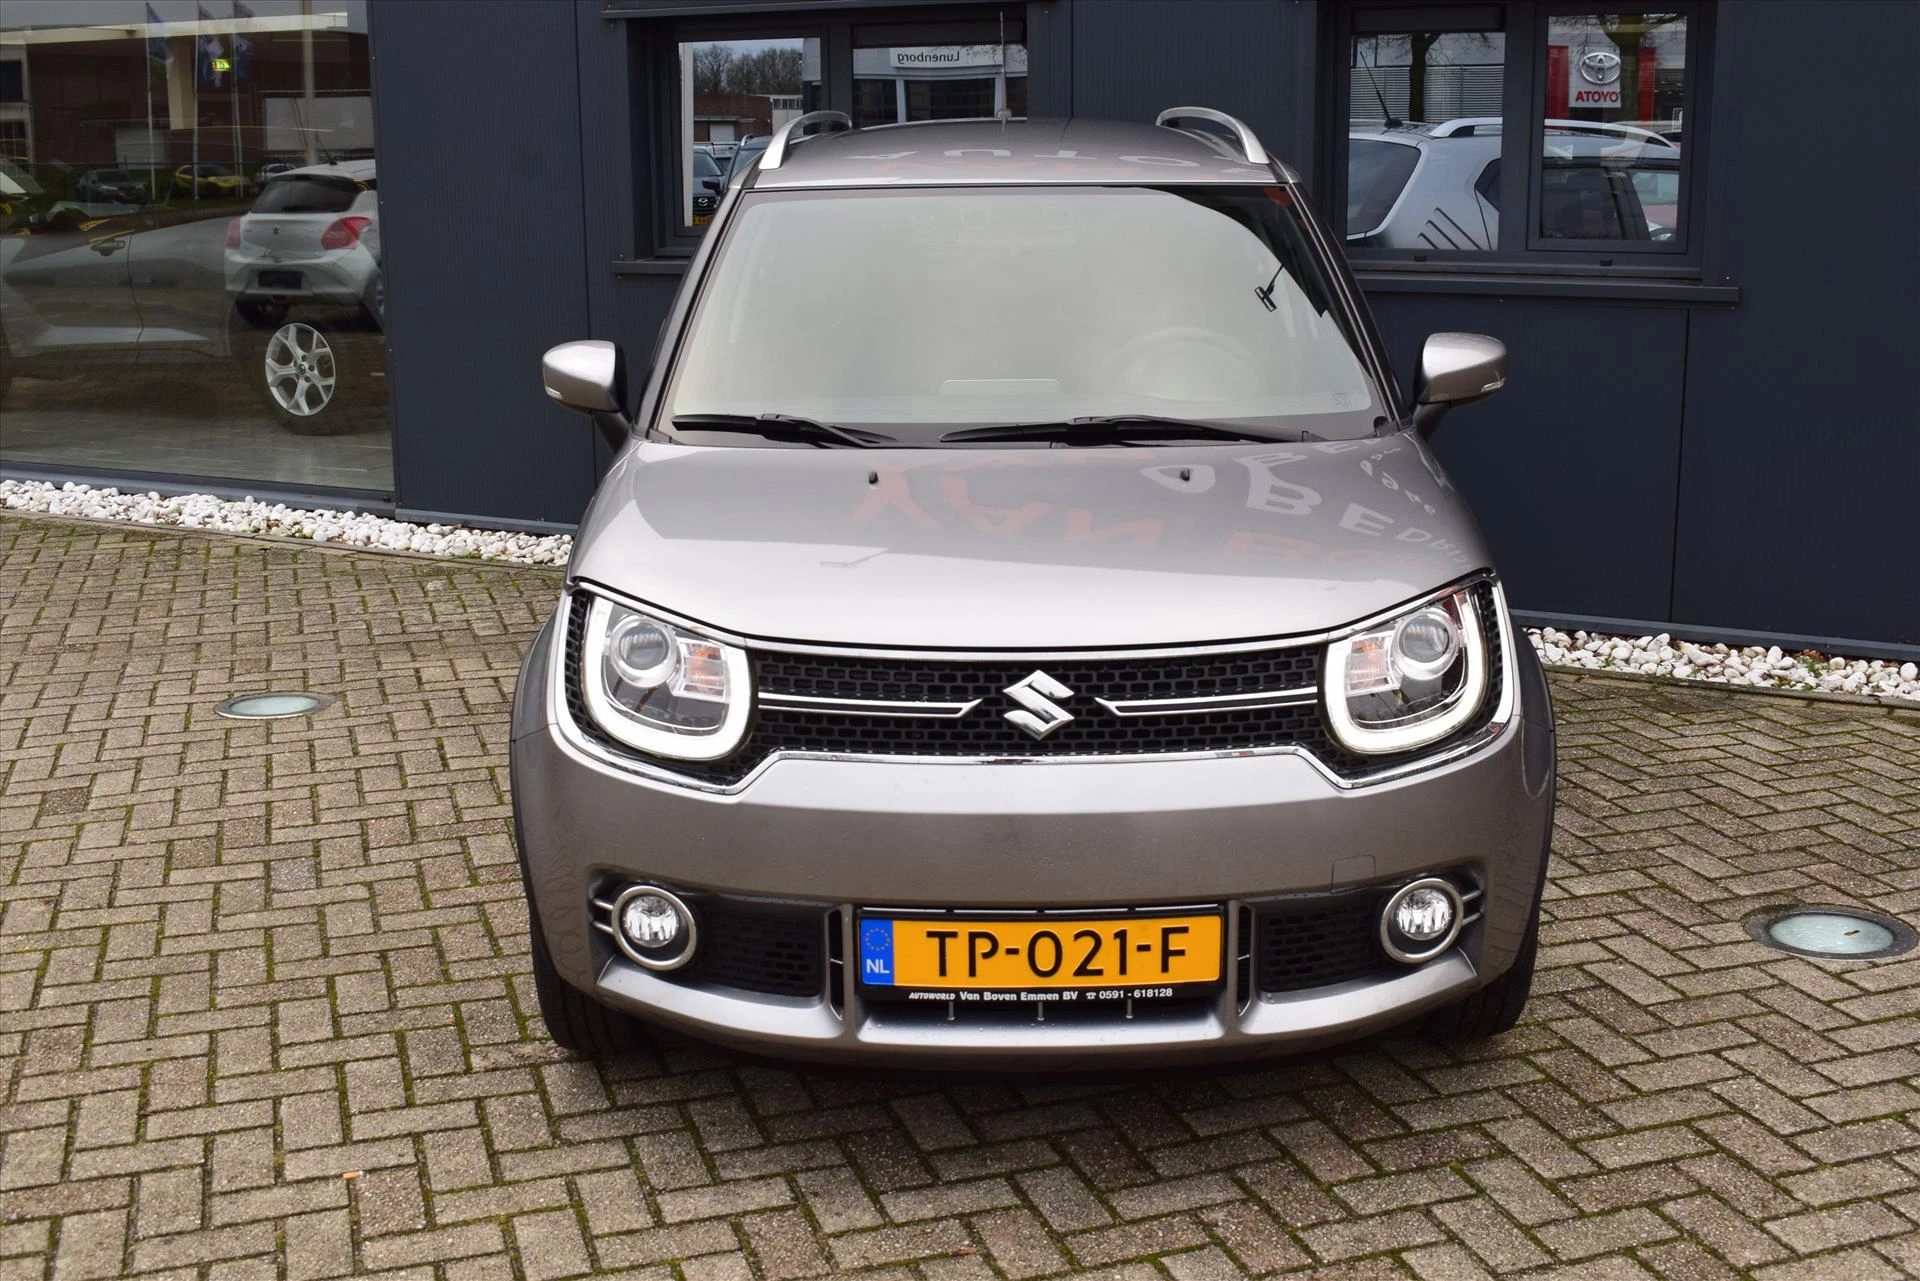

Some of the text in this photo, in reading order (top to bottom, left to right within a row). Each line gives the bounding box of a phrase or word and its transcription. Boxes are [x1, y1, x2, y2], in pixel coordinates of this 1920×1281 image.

[925, 925, 1190, 978] TP-021-F
[865, 958, 890, 974] NL
[908, 991, 956, 1001] AUTOWORLD
[959, 991, 980, 1001] Van
[983, 991, 1017, 1001] Boven
[1020, 991, 1059, 1001] Emmen
[1062, 991, 1078, 1001] BV
[1098, 990, 1125, 1000] 0591
[1133, 988, 1173, 999] 618128
